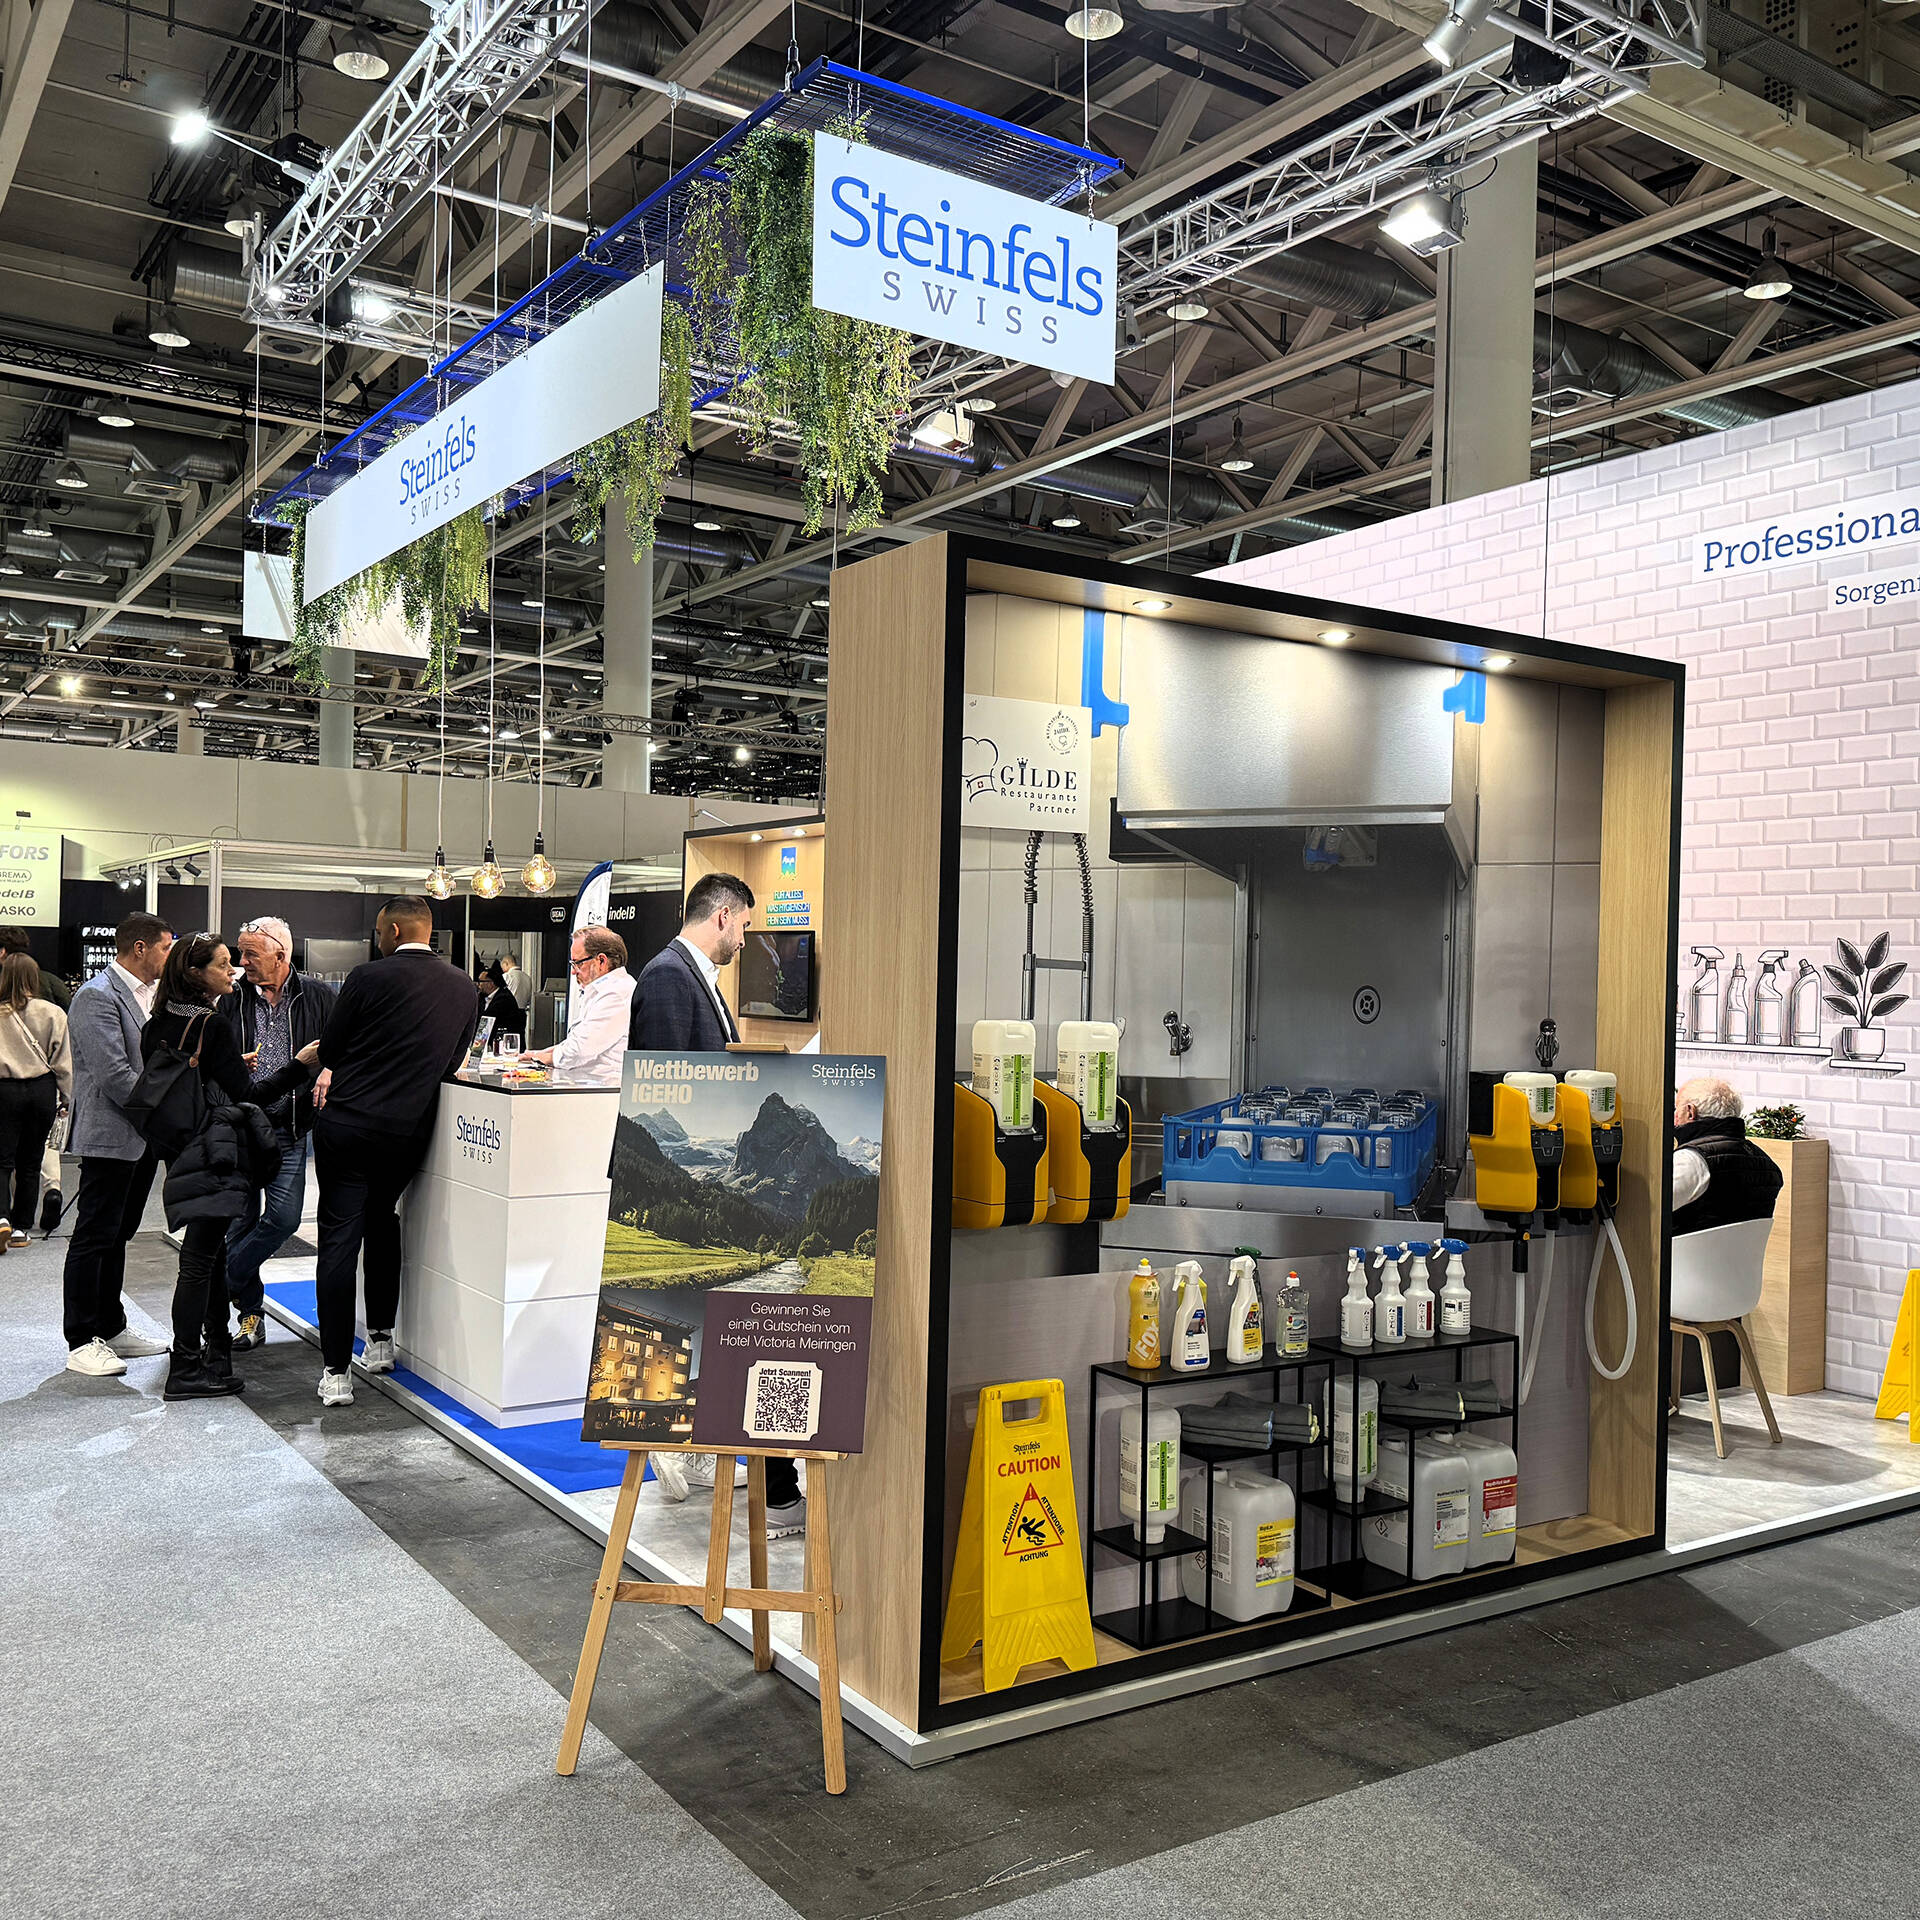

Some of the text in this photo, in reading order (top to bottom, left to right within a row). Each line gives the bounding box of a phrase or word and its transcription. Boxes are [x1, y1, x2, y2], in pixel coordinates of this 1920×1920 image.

[830, 176, 1103, 316] Steinfels
[882, 270, 1058, 344] SWISS
[400, 415, 476, 505] Steinfels
[411, 477, 461, 525] SWISS
[1835, 574, 1920, 605] Sorgen
[1000, 765, 1077, 790] GILDE
[1000, 787, 1077, 802] Restaurants
[1029, 802, 1076, 815] Partner
[0, 889, 35, 898] delB
[0, 905, 36, 916] ASKO
[94, 927, 117, 937] FOR
[633, 1059, 759, 1081] Wettbewerb
[812, 1063, 876, 1079] Steinfels
[822, 1079, 864, 1087] SWISS
[632, 1083, 692, 1104] IGEHO
[456, 1114, 501, 1150] Steinfels
[463, 1145, 493, 1164] SWISS
[750, 1302, 831, 1316] Gewinnen Sie
[728, 1319, 850, 1334] einen Gutschein vom
[720, 1334, 856, 1353] Hotel Victoria Meiringen
[779, 1369, 811, 1377] Scannen!
[998, 1456, 1060, 1477] CAUTION
[1002, 1502, 1020, 1544] ATTENTION
[1041, 1496, 1065, 1535] ATTENZIONE
[1019, 1550, 1048, 1562] ACHTUNG
